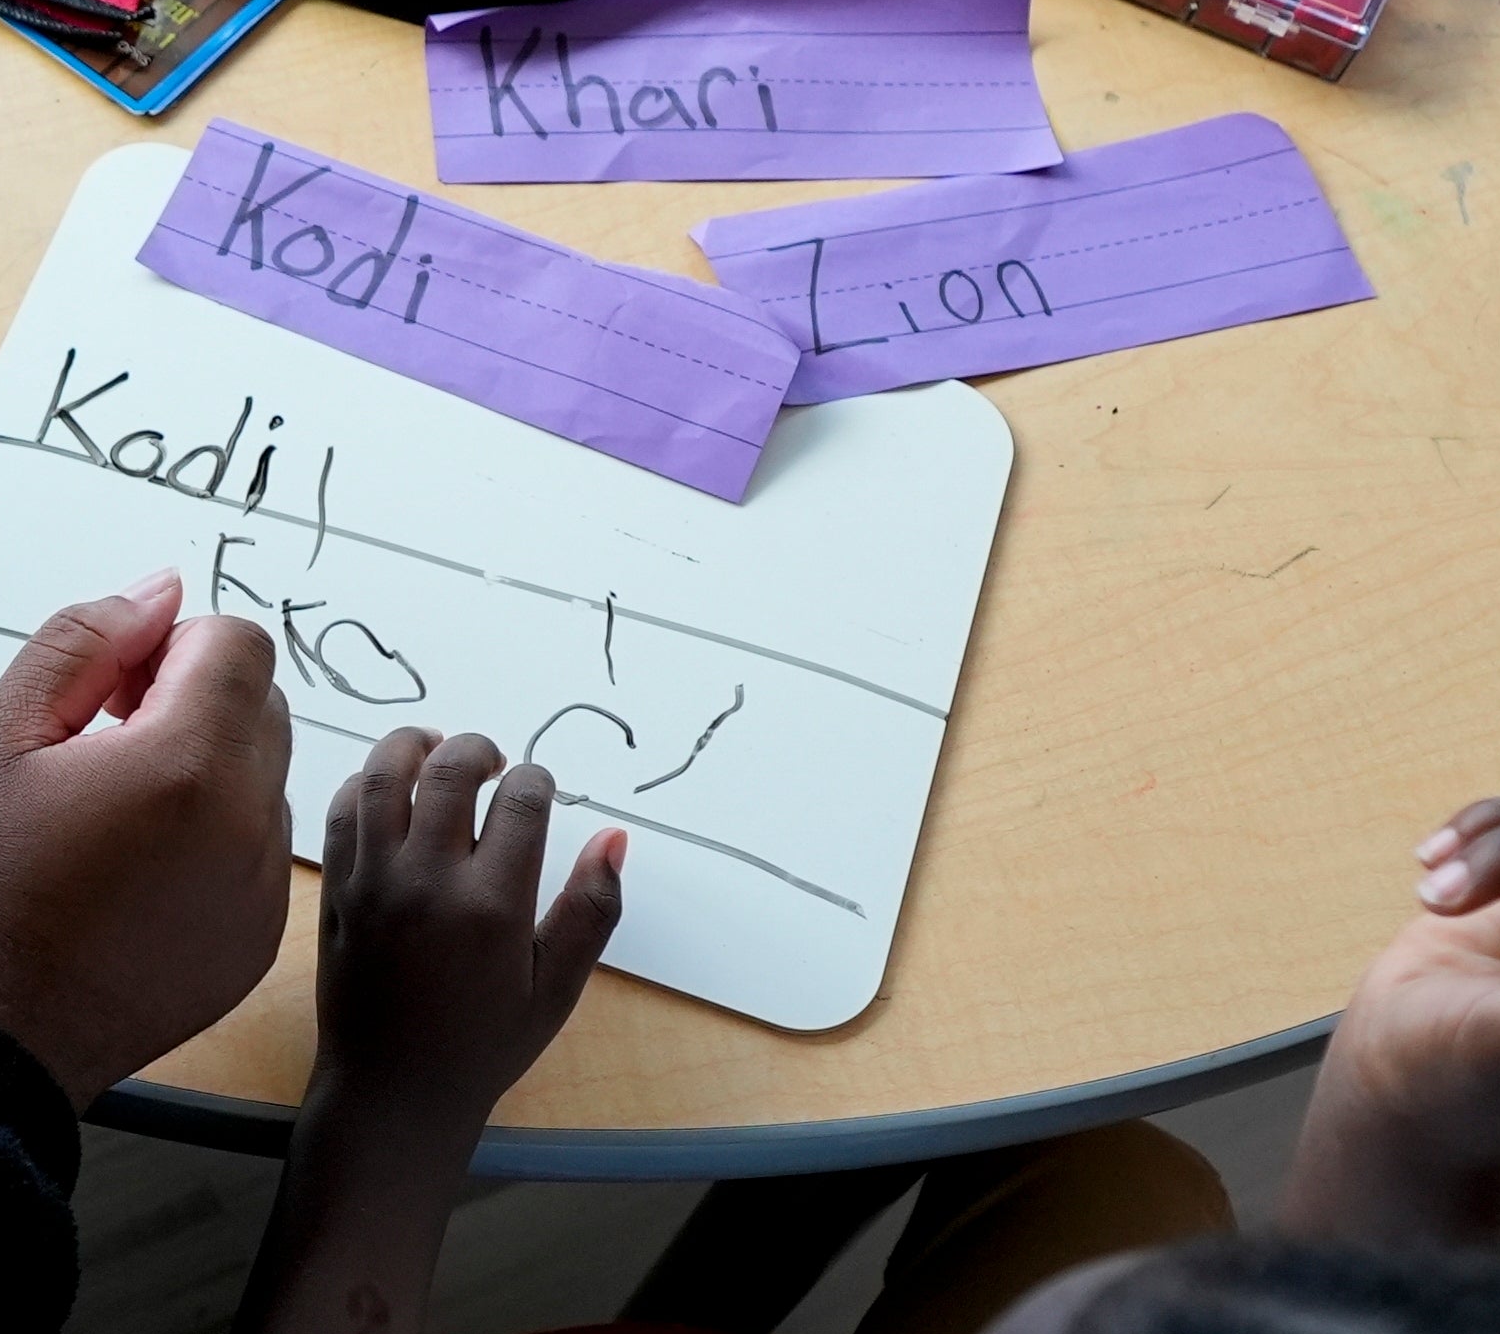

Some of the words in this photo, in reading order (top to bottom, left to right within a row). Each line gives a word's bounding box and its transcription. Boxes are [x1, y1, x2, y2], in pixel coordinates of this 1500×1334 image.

[479, 25, 778, 141] Khari
[217, 142, 432, 324] Kodi
[767, 238, 1052, 355] Zion
